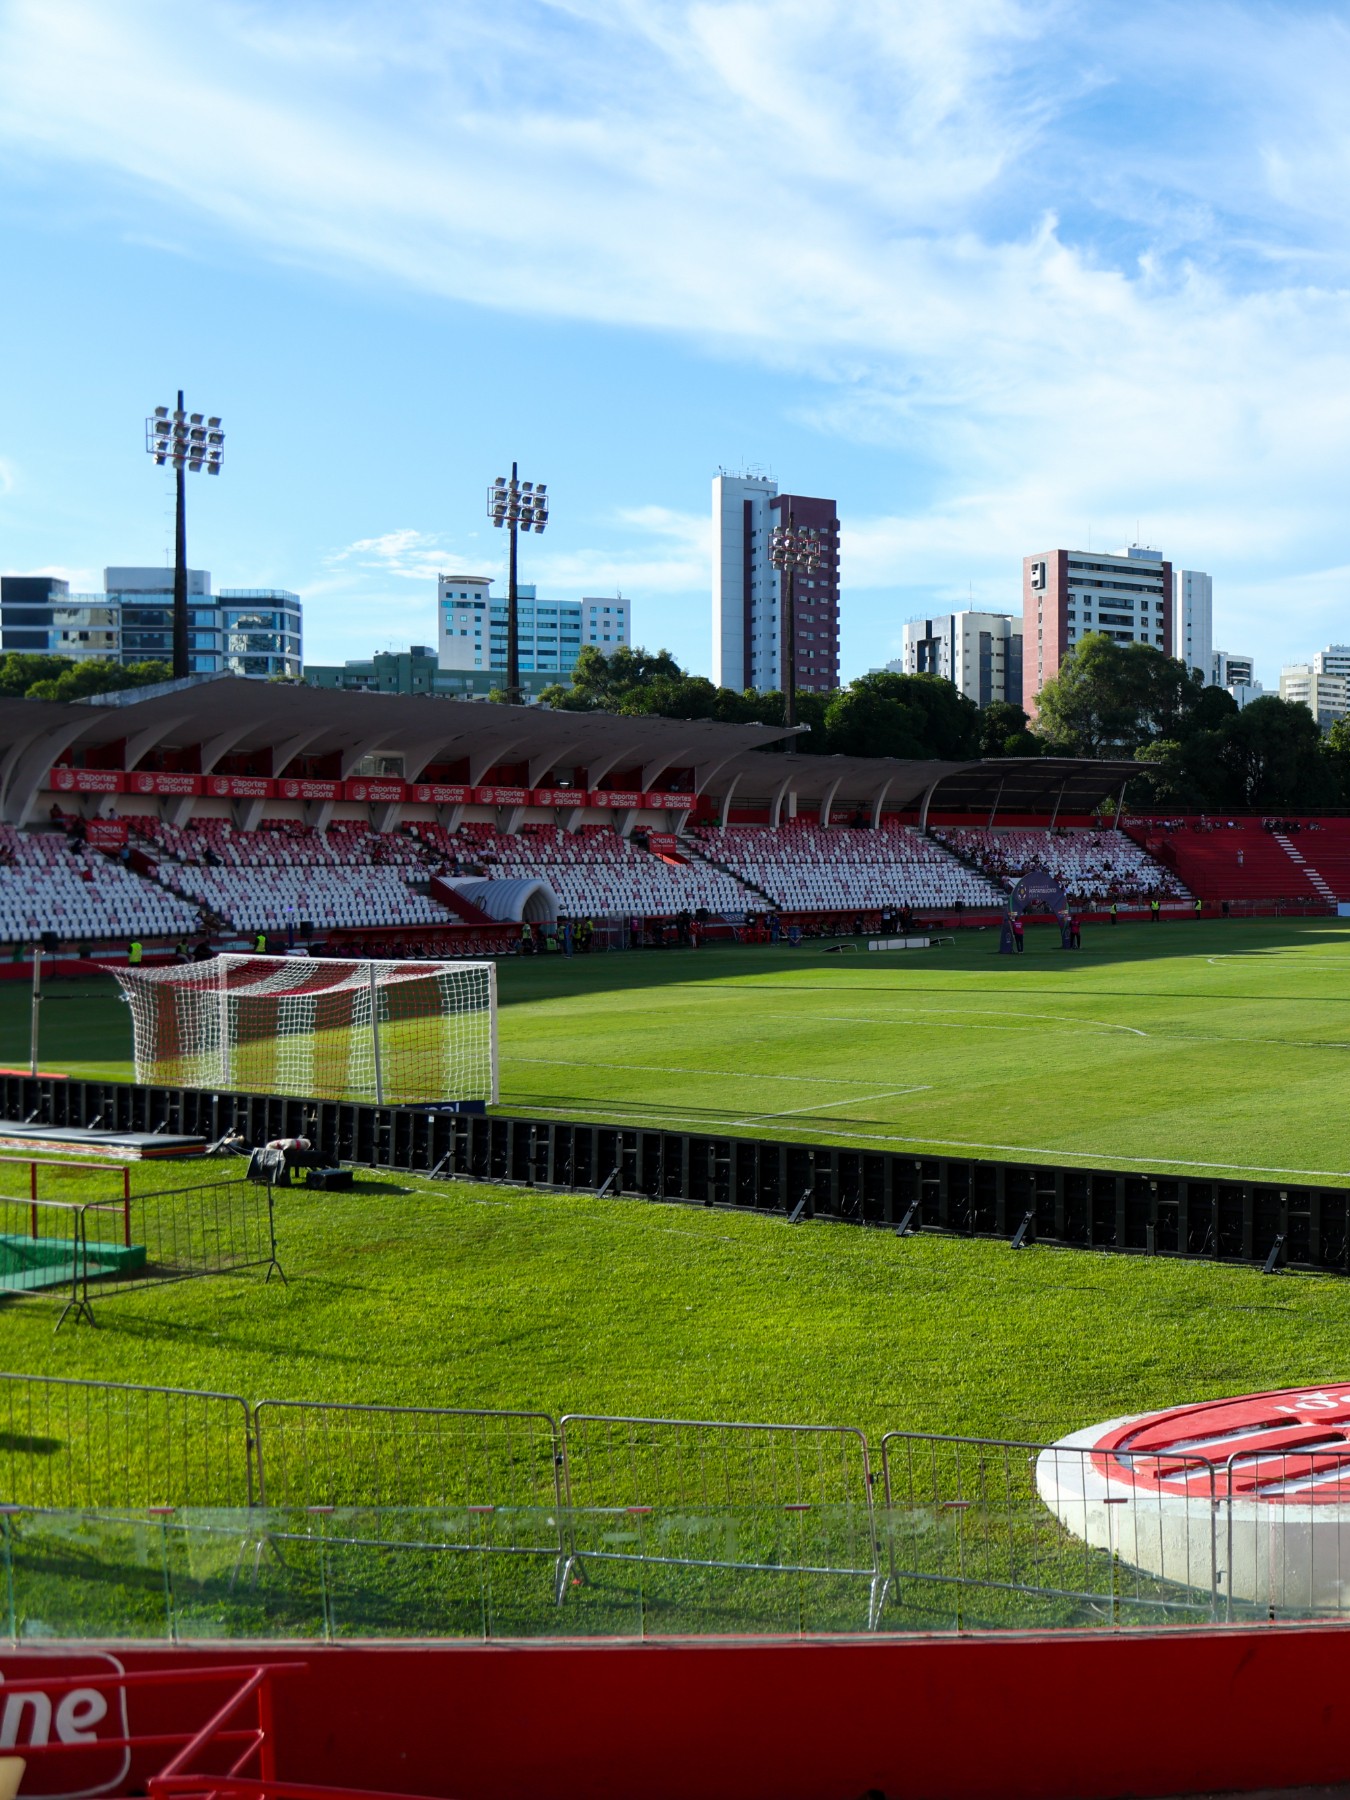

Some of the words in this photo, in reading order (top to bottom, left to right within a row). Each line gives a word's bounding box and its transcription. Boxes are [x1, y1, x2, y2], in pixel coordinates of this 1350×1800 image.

[77, 773, 118, 784] Esportes
[156, 776, 194, 785] Esportes
[91, 782, 115, 791] Sorte
[232, 779, 268, 788] Esportes
[301, 782, 335, 791] Esportes
[170, 784, 192, 793] Sorte
[244, 788, 265, 796] Sorte
[369, 785, 401, 794] Esportes
[433, 787, 464, 796] Esportes
[553, 792, 582, 800] Esportes
